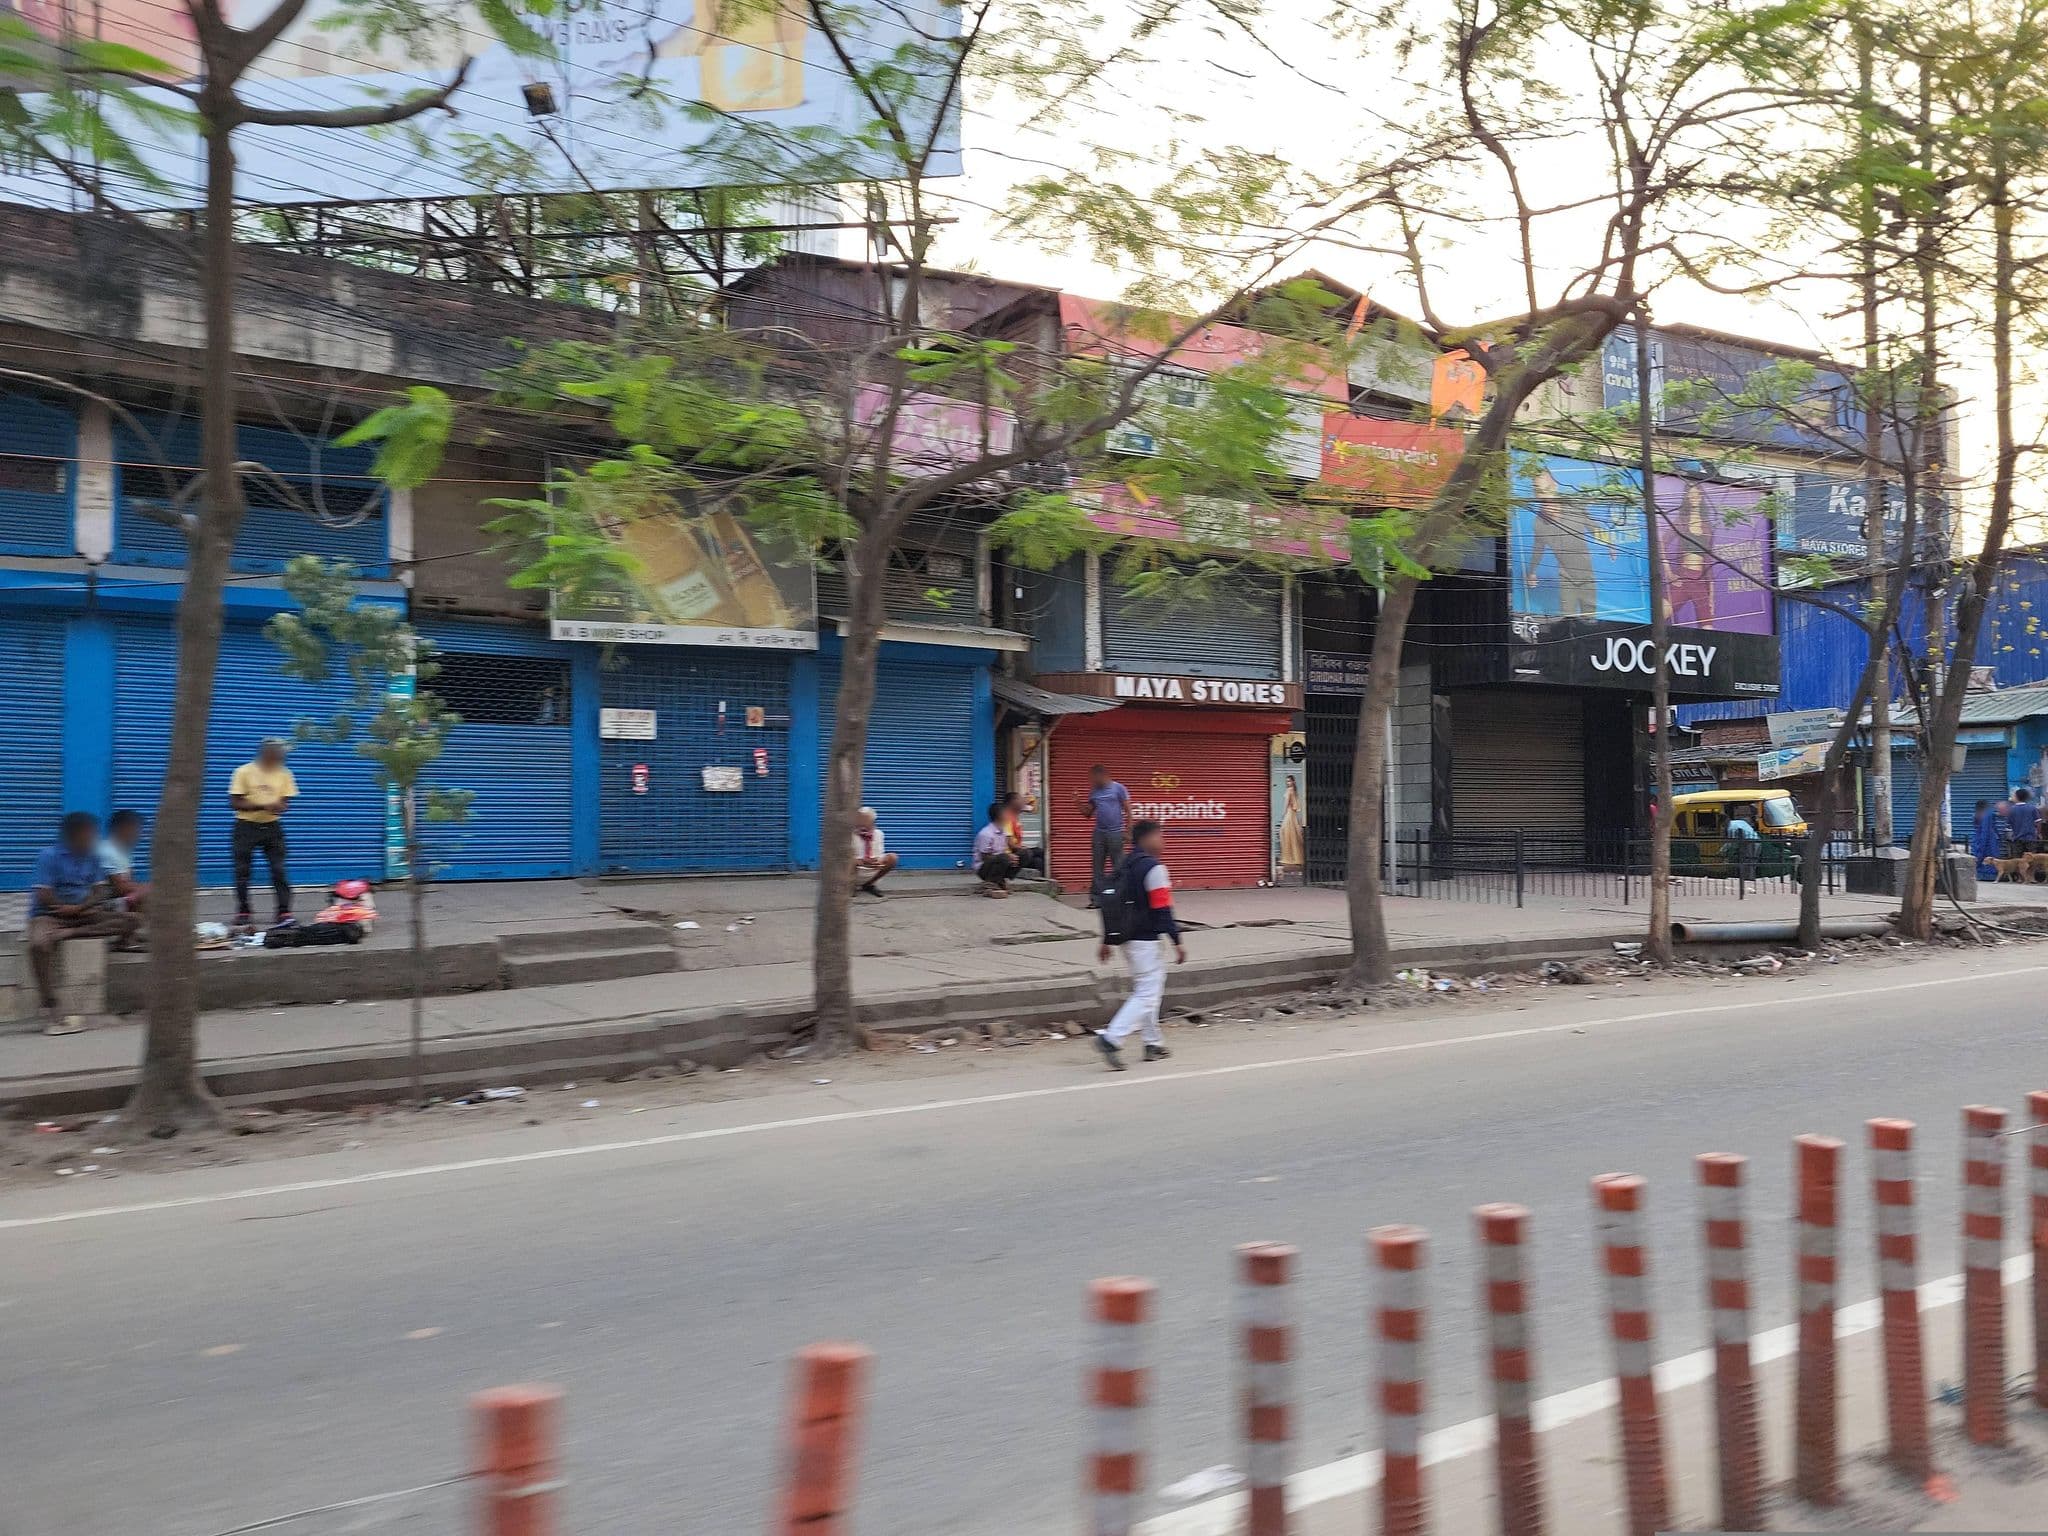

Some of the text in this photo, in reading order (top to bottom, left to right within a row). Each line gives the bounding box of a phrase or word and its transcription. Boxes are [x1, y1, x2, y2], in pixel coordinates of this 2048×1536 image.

[1800, 539, 1868, 557] MAYA STORES
[627, 629, 665, 640] SHOP
[1590, 637, 1716, 677] JOCKEY
[1115, 676, 1286, 704] MAYA STORES
